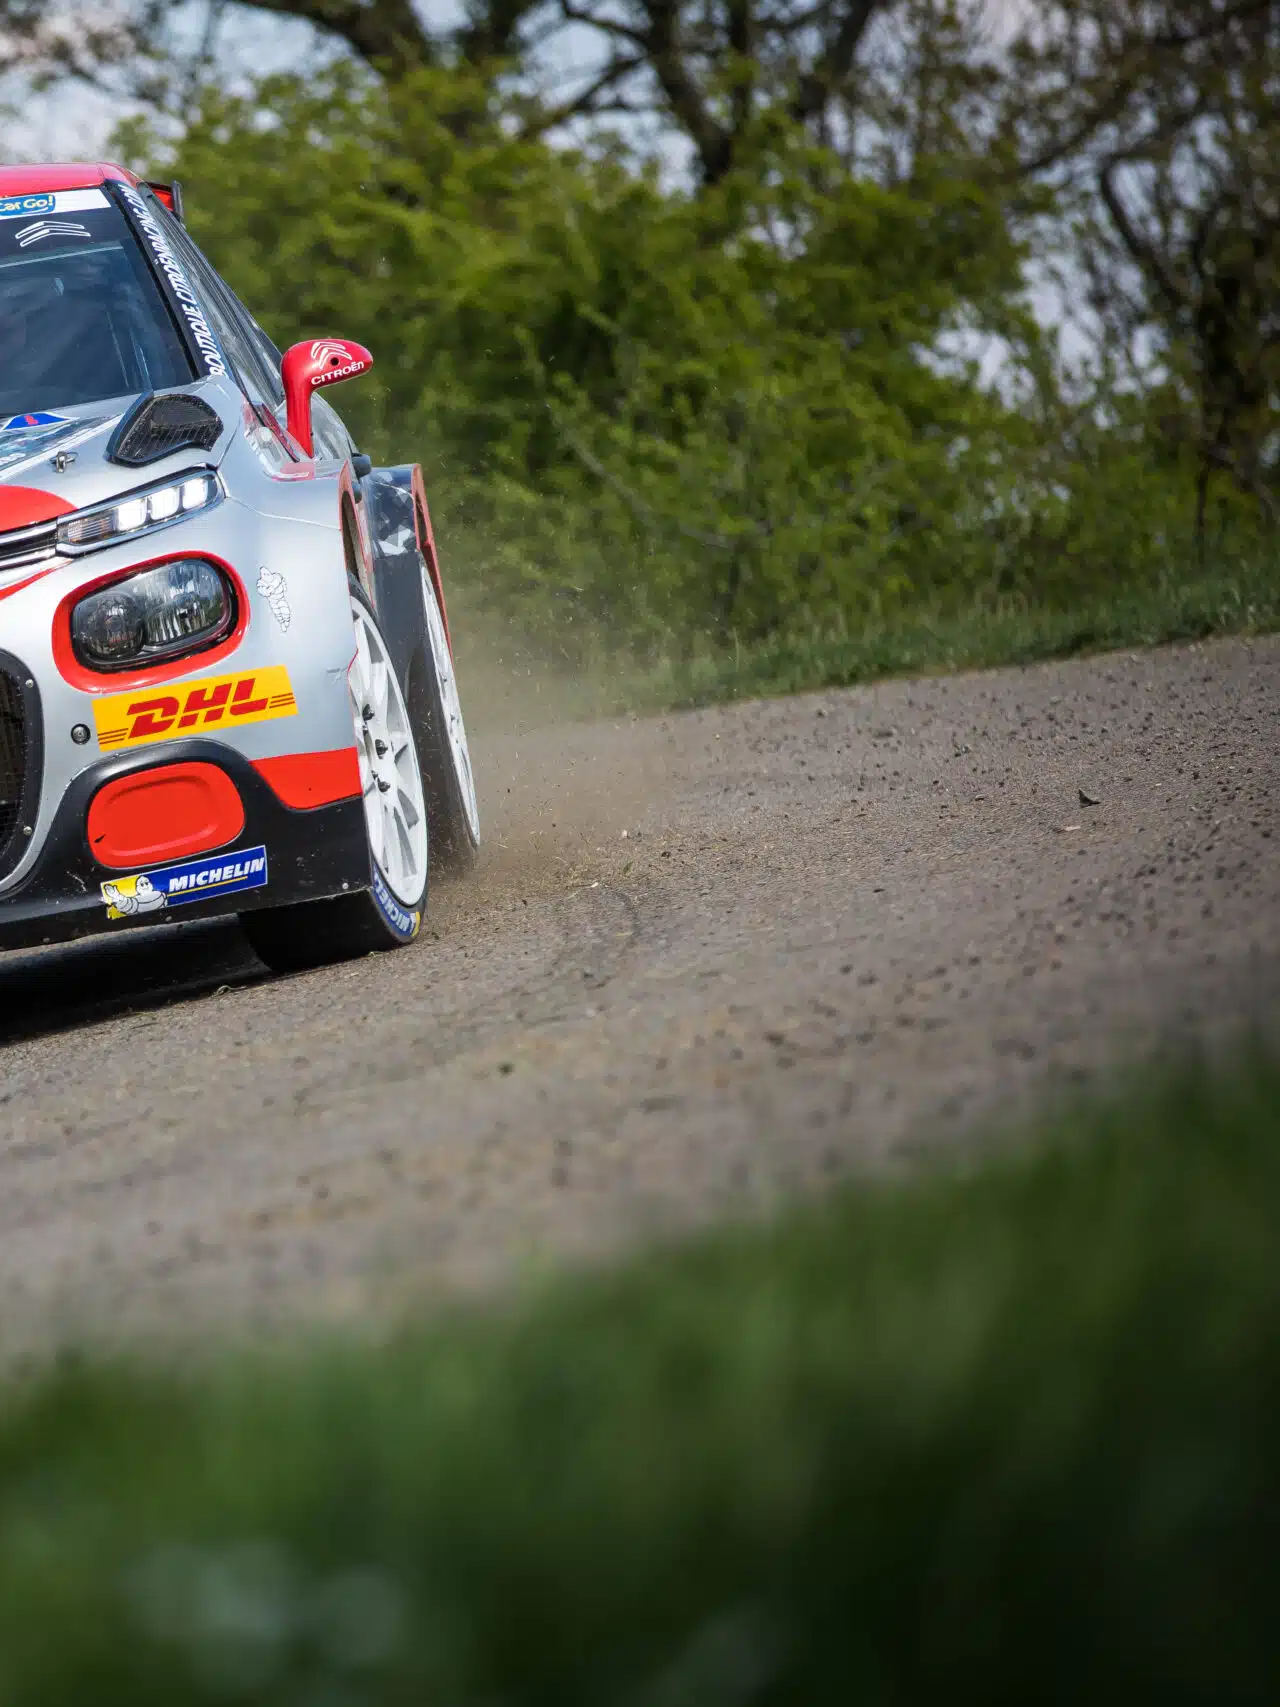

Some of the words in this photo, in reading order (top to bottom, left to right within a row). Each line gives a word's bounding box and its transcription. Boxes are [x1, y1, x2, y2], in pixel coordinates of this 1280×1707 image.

[22, 194, 54, 209] Go!
[181, 301, 229, 381] BOUTIQUE
[310, 360, 365, 385] CITROËN
[126, 677, 270, 740] DHL
[168, 856, 266, 894] MICHELIN
